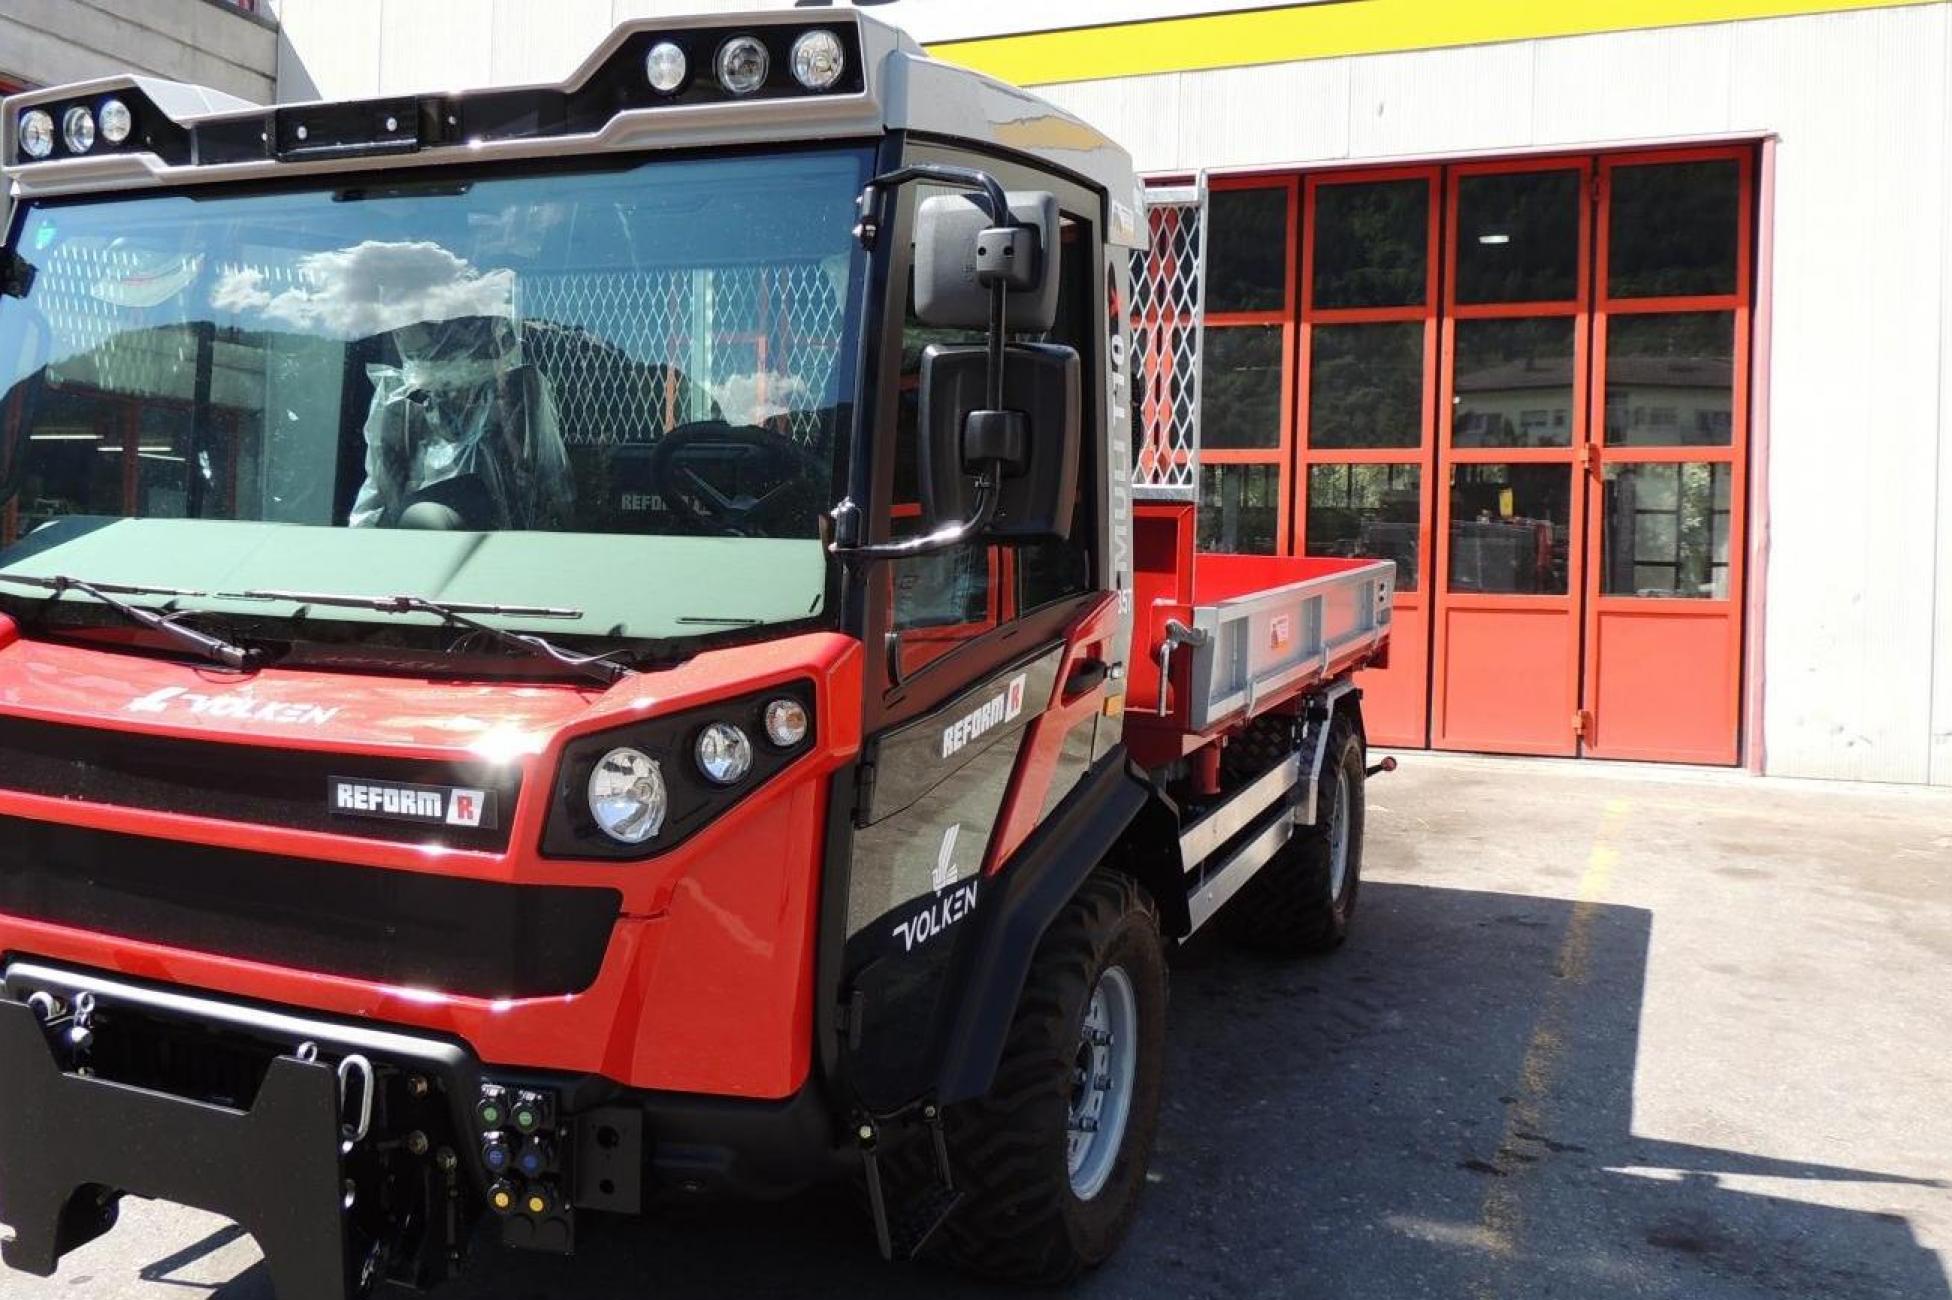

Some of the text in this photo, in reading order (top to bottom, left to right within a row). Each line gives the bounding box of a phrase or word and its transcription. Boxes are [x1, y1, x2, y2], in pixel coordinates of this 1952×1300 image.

[1113, 440, 1128, 572] MULI
[179, 693, 341, 725] VOLKEN
[943, 692, 1005, 759] REFORM
[337, 783, 442, 817] REFORM
[892, 880, 977, 951] VOLKEN
